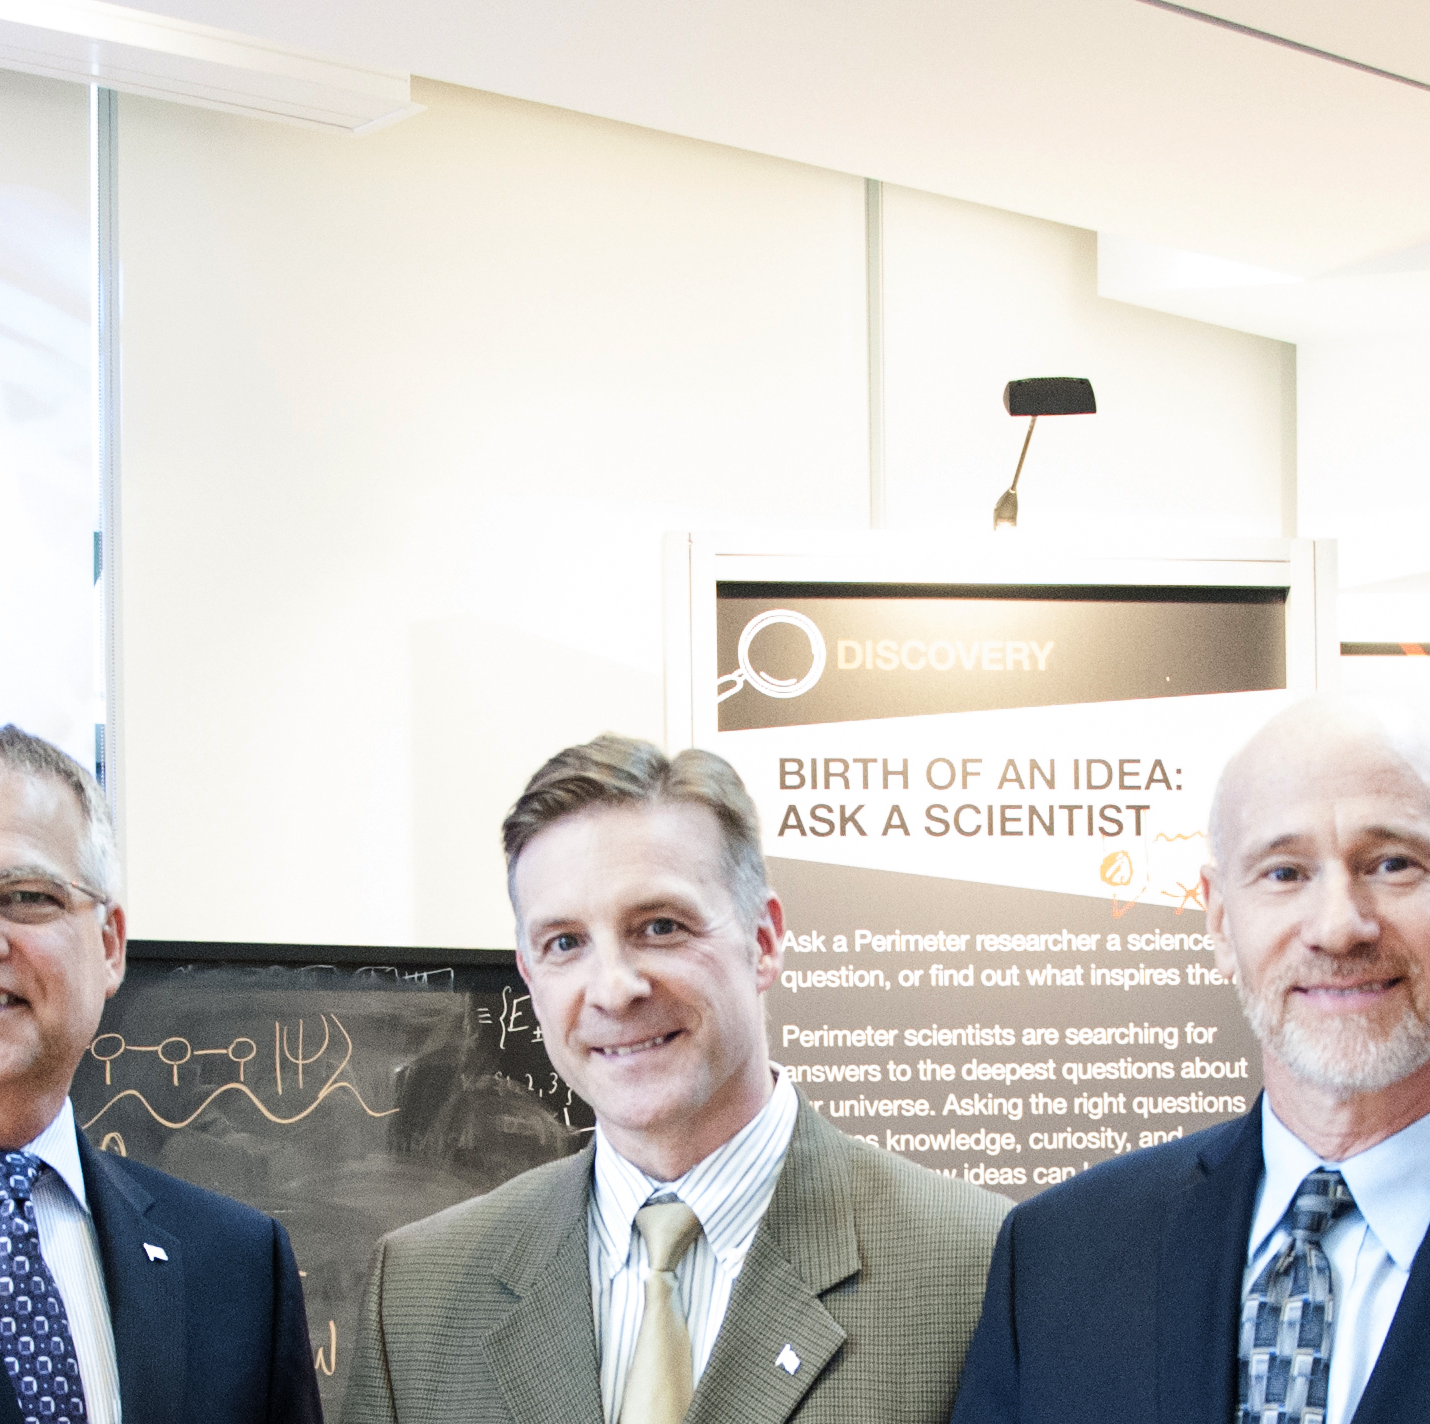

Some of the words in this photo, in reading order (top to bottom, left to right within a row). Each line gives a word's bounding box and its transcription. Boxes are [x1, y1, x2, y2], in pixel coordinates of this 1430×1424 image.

[836, 640, 1055, 672] DISCOVERY
[780, 759, 909, 791] BIRTH
[927, 759, 983, 791] OF
[999, 760, 1056, 790] AN
[1075, 760, 1183, 791] IDEA:
[779, 805, 868, 838] ASK
[882, 806, 911, 837] A
[926, 805, 1151, 838] SCIENTIST
[781, 932, 827, 953] Ask
[834, 936, 848, 953] a
[856, 931, 971, 952] Perimeter
[977, 930, 1101, 952] researcher
[1108, 935, 1122, 951] a
[1129, 930, 1214, 951] science
[783, 966, 891, 993] question,
[900, 971, 924, 987] or
[931, 966, 974, 987] find
[982, 967, 1020, 987] out
[1027, 965, 1084, 986] what
[1092, 965, 1181, 991] inspires
[1188, 965, 1236, 985] the
[784, 1027, 899, 1048] Perimeter
[906, 1025, 1016, 1047] scientists
[1023, 1030, 1060, 1046] are
[1067, 1024, 1179, 1050] searching
[1187, 1024, 1218, 1044] for
[786, 1066, 882, 1084] answers
[888, 1062, 912, 1082] to
[919, 1061, 956, 1081] the
[963, 1060, 1056, 1085] deepest
[1064, 1059, 1175, 1085] questions
[1182, 1058, 1248, 1079] about
[832, 1096, 936, 1117] universe.
[944, 1095, 1023, 1121] Asking
[1031, 1093, 1068, 1115] the
[1076, 1094, 1126, 1120] right
[1134, 1093, 1246, 1118] questions
[888, 1130, 1021, 1156] knowledge,
[1031, 1129, 1131, 1154] curiosity,
[1141, 1128, 1183, 1148] and
[966, 1165, 1027, 1185] ideas
[1035, 1169, 1076, 1184] can
